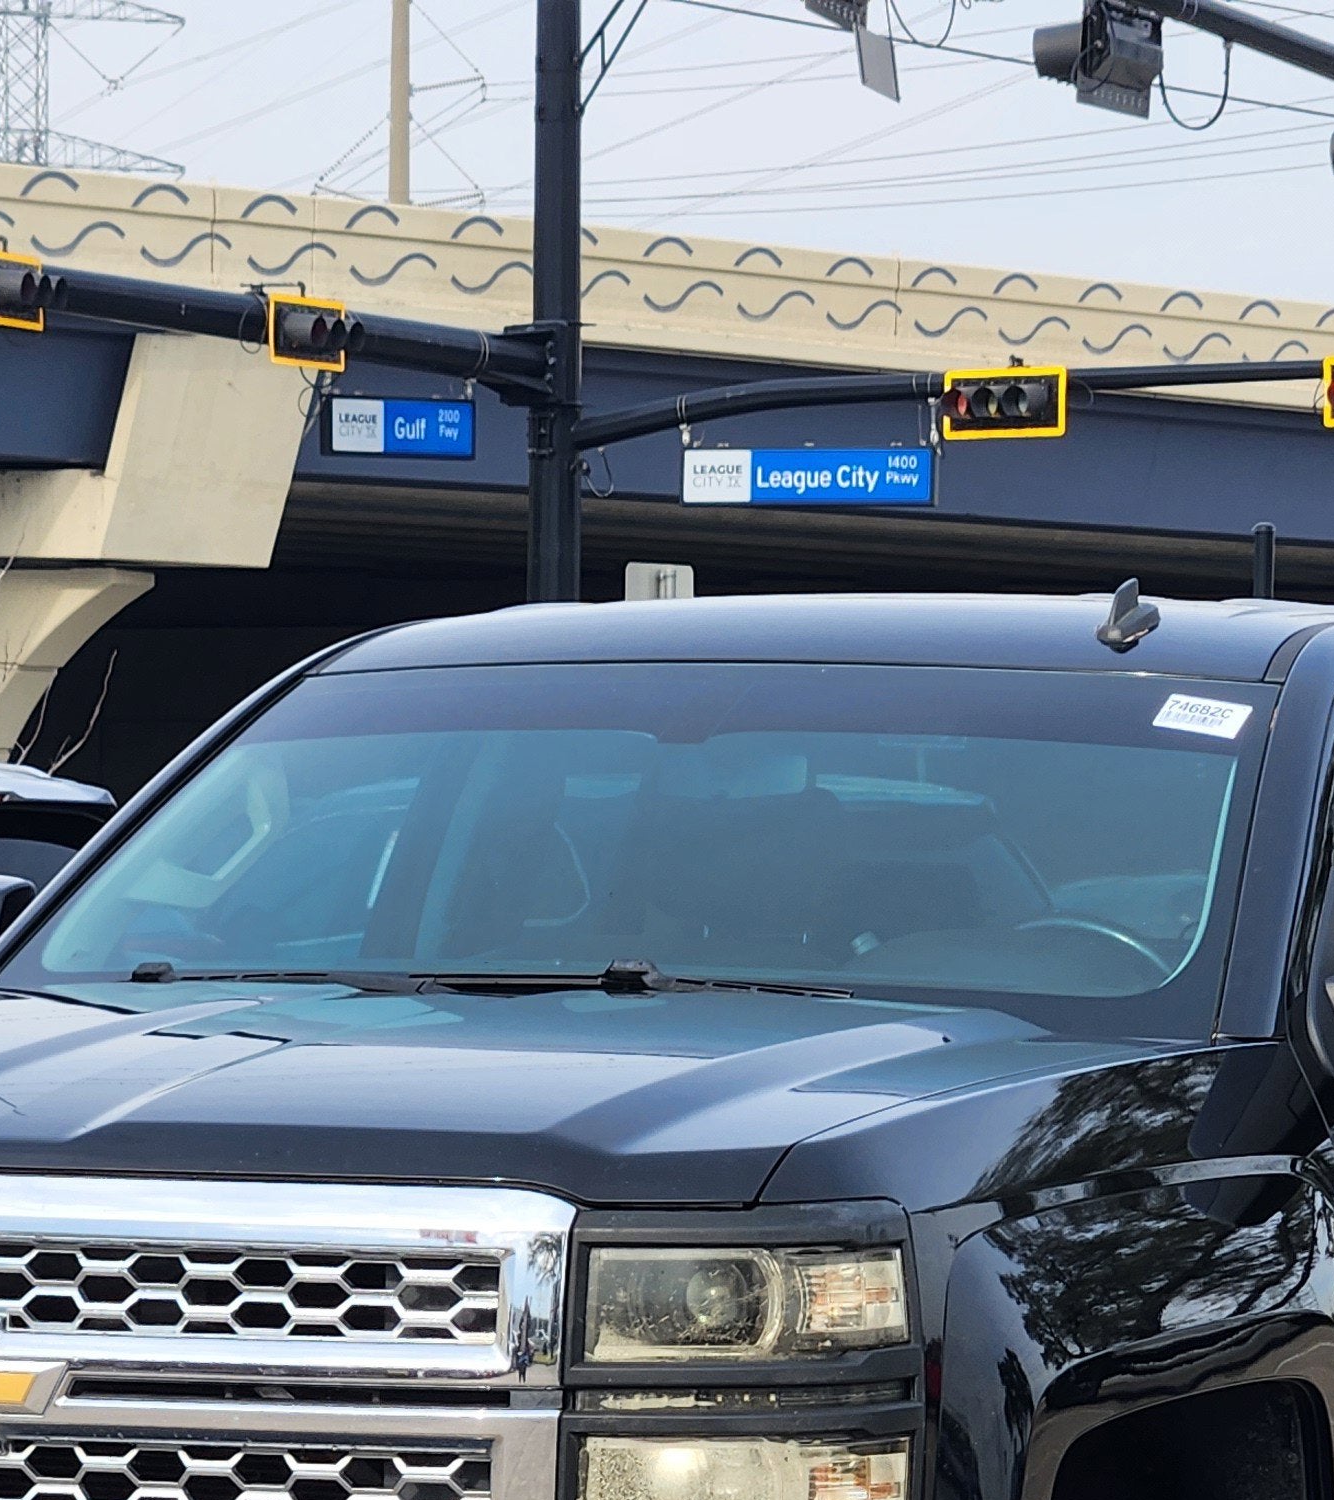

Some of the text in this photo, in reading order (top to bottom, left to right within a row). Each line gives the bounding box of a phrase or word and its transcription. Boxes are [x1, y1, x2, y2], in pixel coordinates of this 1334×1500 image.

[338, 413, 378, 424] LEAGUE
[438, 409, 460, 424] 2100
[338, 425, 363, 437] CITY
[394, 416, 427, 440] Gulf
[438, 424, 459, 441] Fwy
[887, 455, 918, 469] 1400
[693, 464, 743, 475] LEAGUE
[692, 477, 725, 488] CITY
[756, 464, 880, 495] League City
[885, 471, 919, 487] Pkwy
